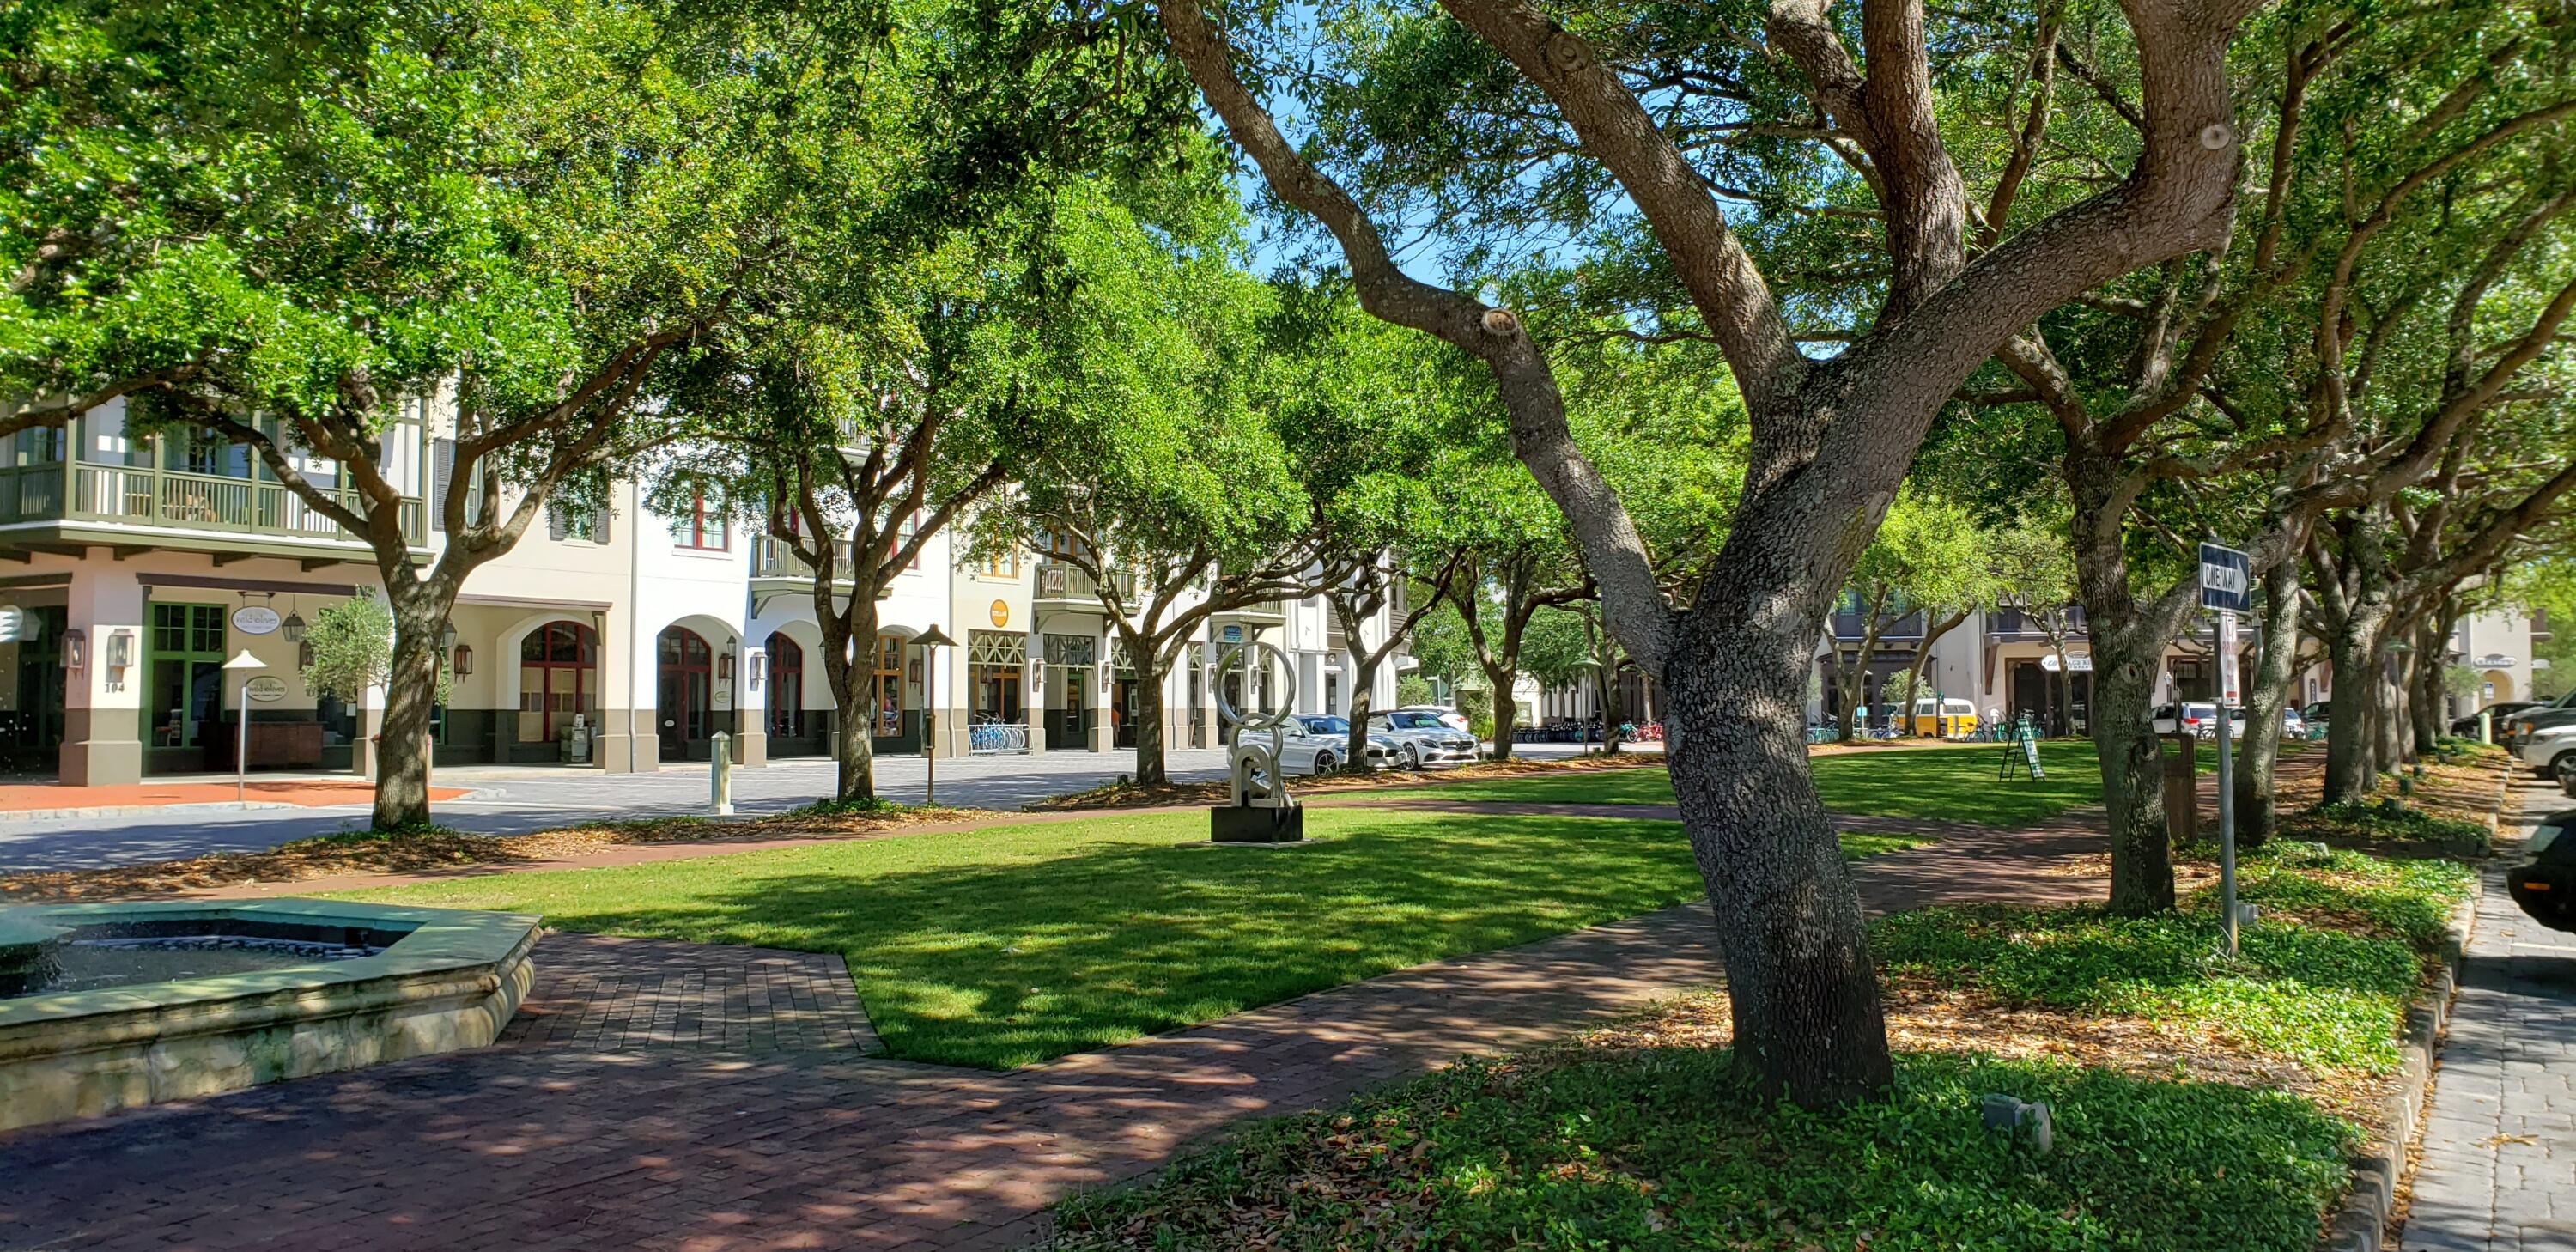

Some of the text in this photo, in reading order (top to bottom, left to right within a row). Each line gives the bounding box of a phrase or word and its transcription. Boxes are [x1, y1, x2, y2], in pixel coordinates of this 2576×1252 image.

[2206, 566, 2236, 590] ONE WAY
[236, 613, 252, 624] wild
[105, 683, 125, 694] 104
[249, 684, 263, 693] wild
